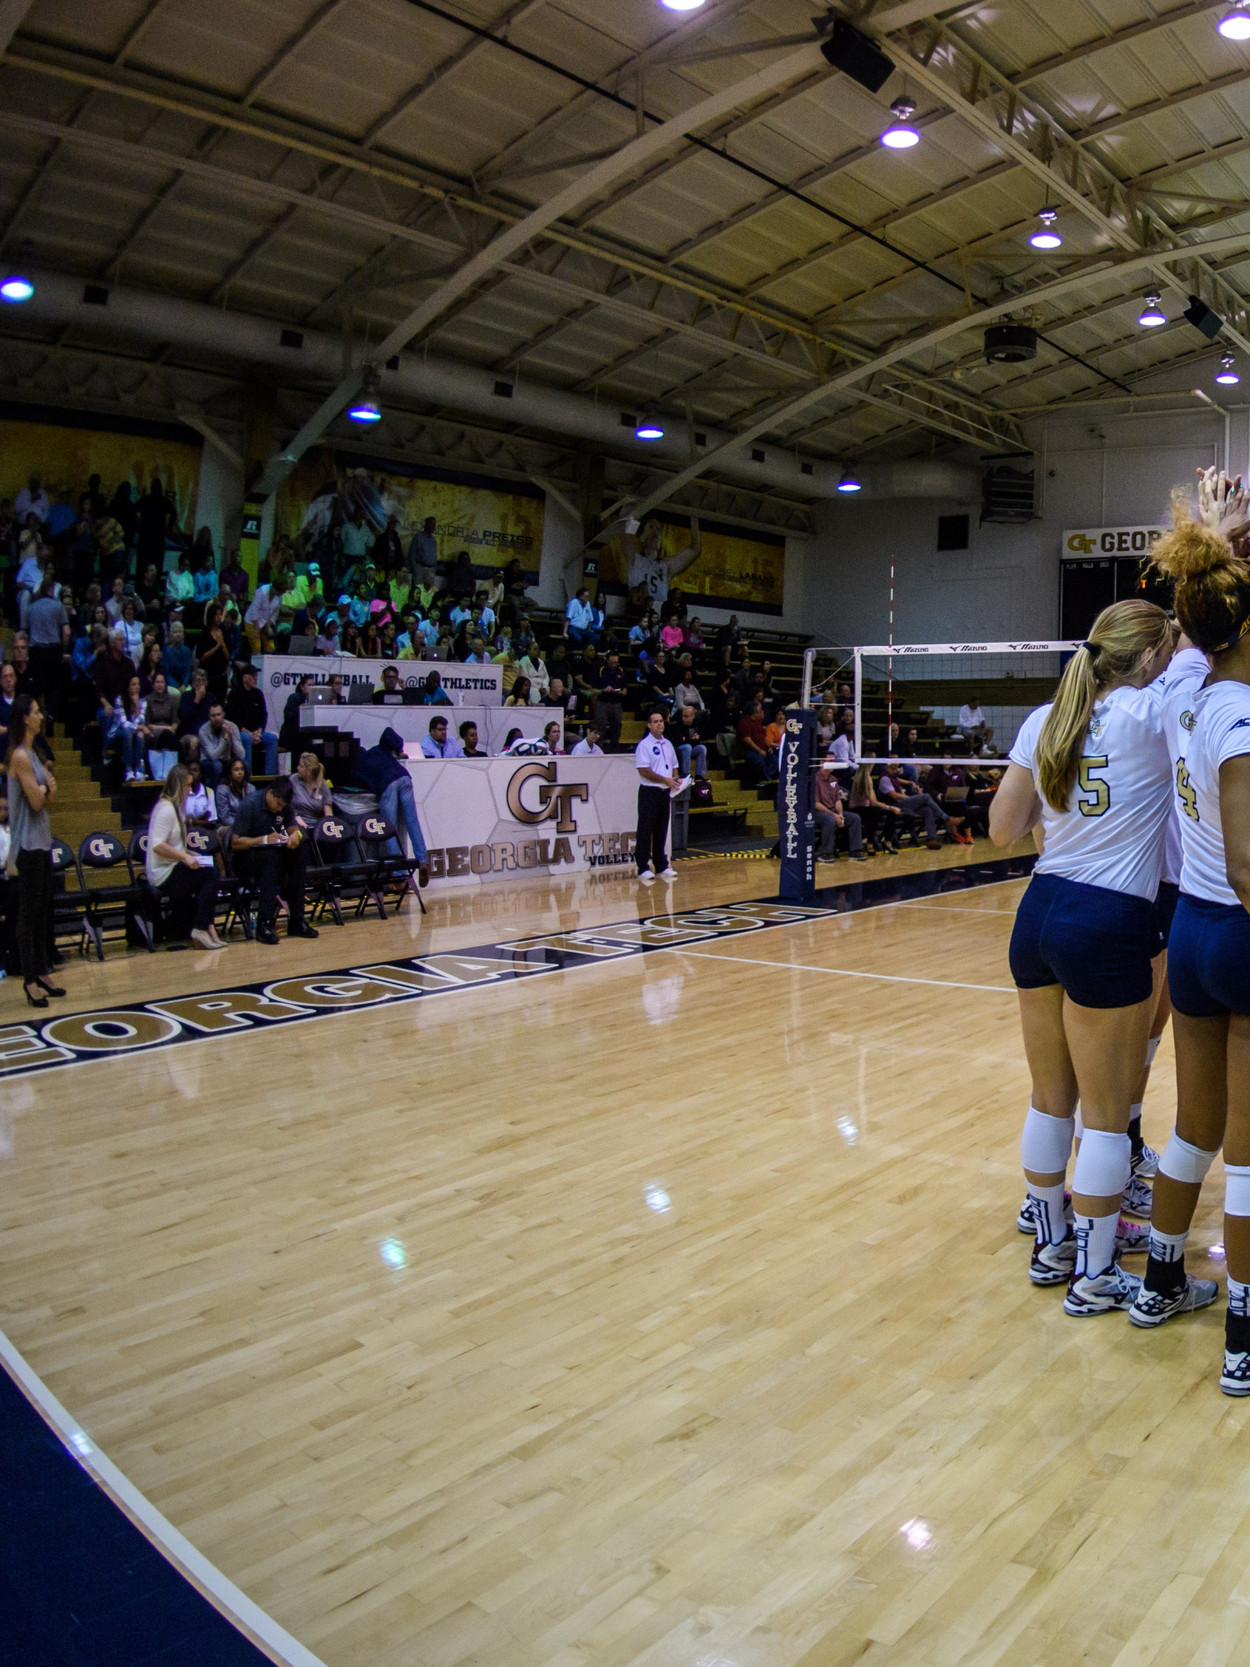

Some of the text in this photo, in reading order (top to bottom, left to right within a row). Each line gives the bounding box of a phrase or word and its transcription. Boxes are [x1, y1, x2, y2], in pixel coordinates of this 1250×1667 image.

[1067, 533, 1097, 554] GT
[786, 719, 803, 735] GT
[506, 761, 589, 833] GT
[785, 741, 799, 859] VOLLEYBALL
[1078, 755, 1110, 817] 5
[322, 821, 344, 838] GT
[365, 818, 386, 835] GT
[90, 838, 114, 859] GT
[427, 832, 637, 878] GEORGIA TEC
[496, 902, 838, 957] TECH
